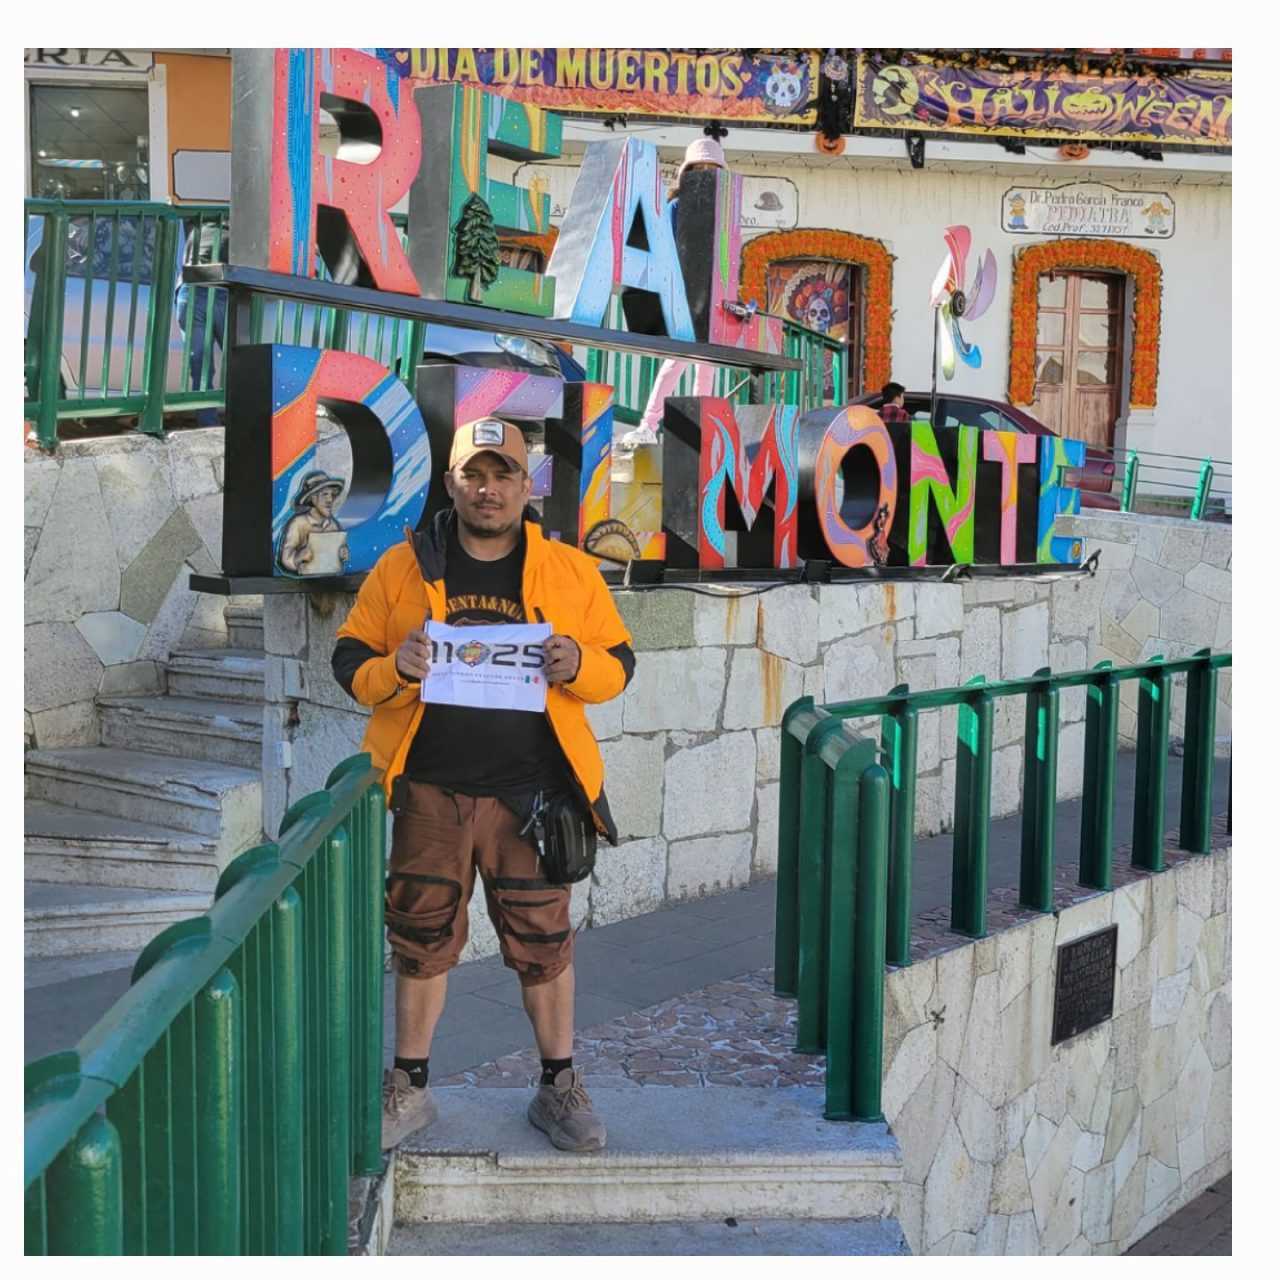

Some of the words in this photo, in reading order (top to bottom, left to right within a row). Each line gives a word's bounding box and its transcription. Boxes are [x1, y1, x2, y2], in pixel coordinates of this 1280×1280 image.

[495, 48, 544, 86] DE
[552, 49, 746, 97] MUERTOS
[231, 48, 783, 344] REAL
[664, 395, 1086, 569] MONTE
[491, 643, 546, 668] 25
